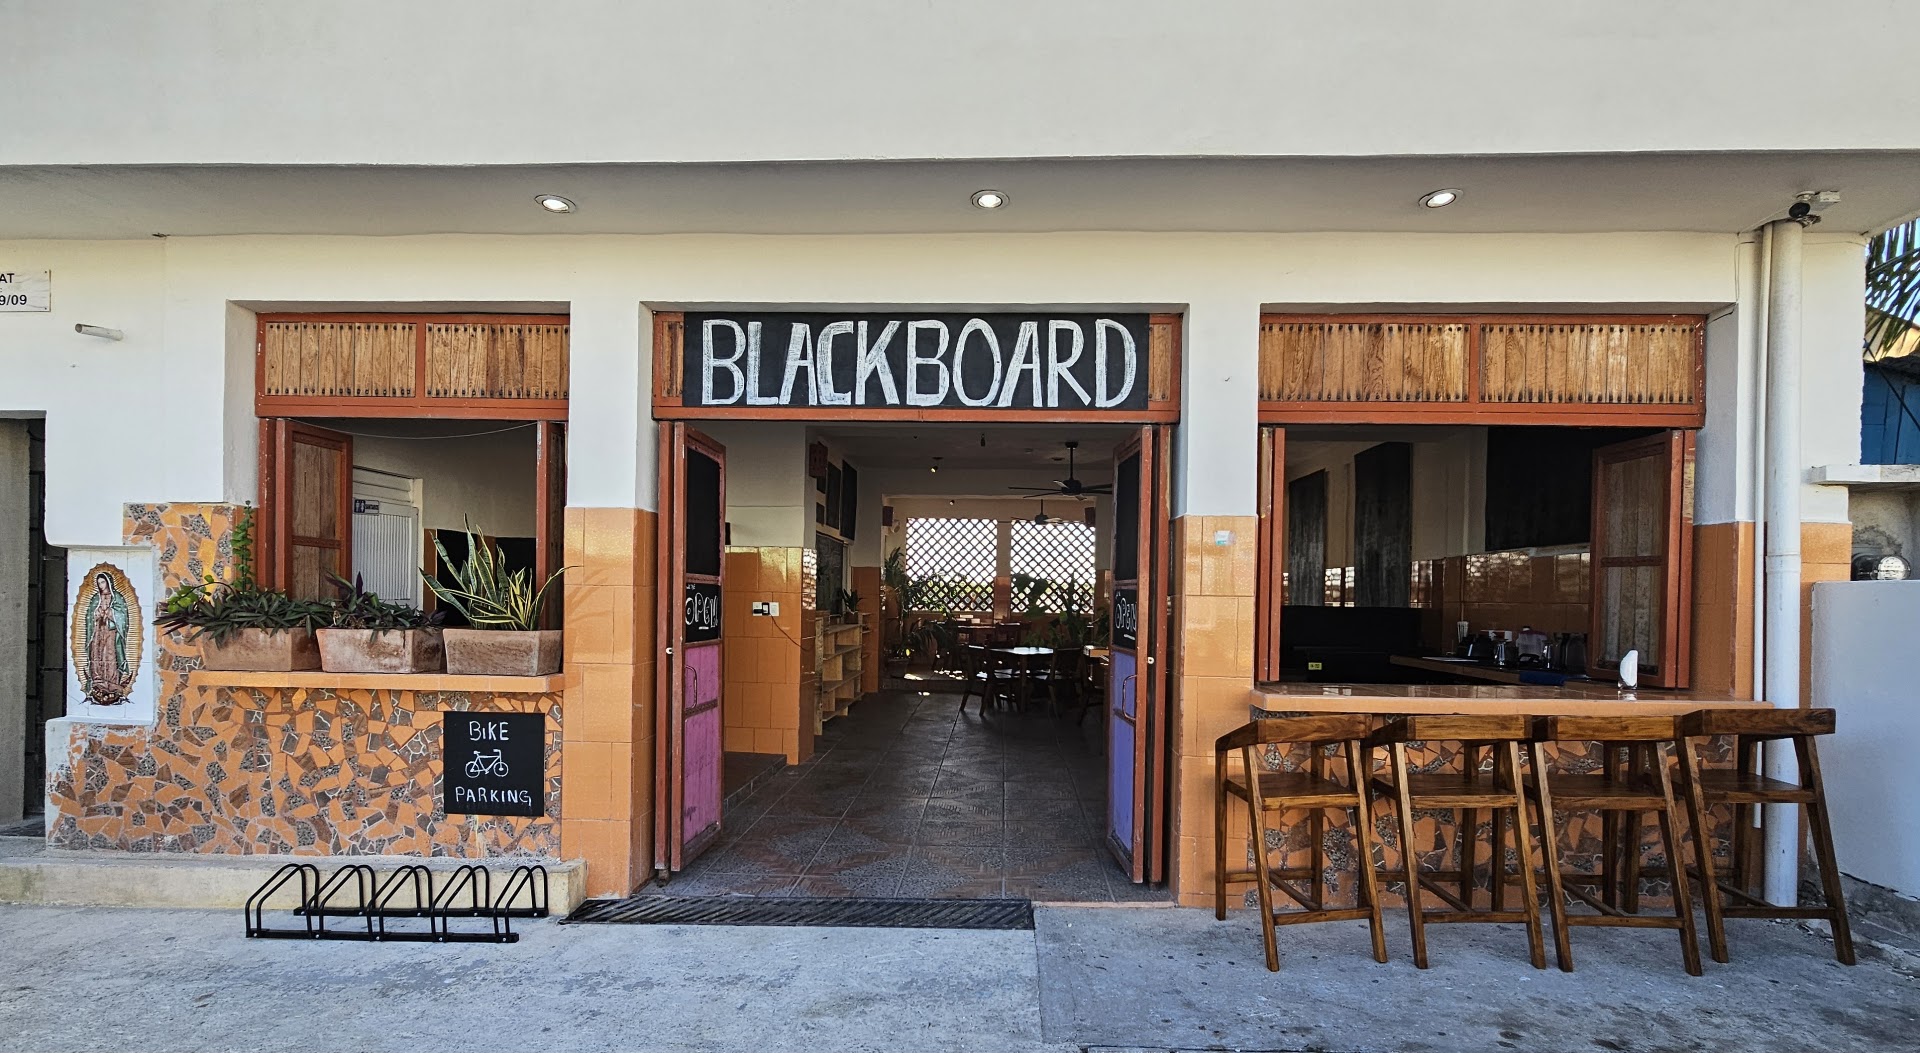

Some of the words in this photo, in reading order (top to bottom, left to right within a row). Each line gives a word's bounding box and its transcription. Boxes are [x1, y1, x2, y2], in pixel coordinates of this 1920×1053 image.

[702, 318, 1137, 407] BLACKBOARD
[1114, 597, 1137, 632] OPEN
[455, 786, 532, 807] PARKING
